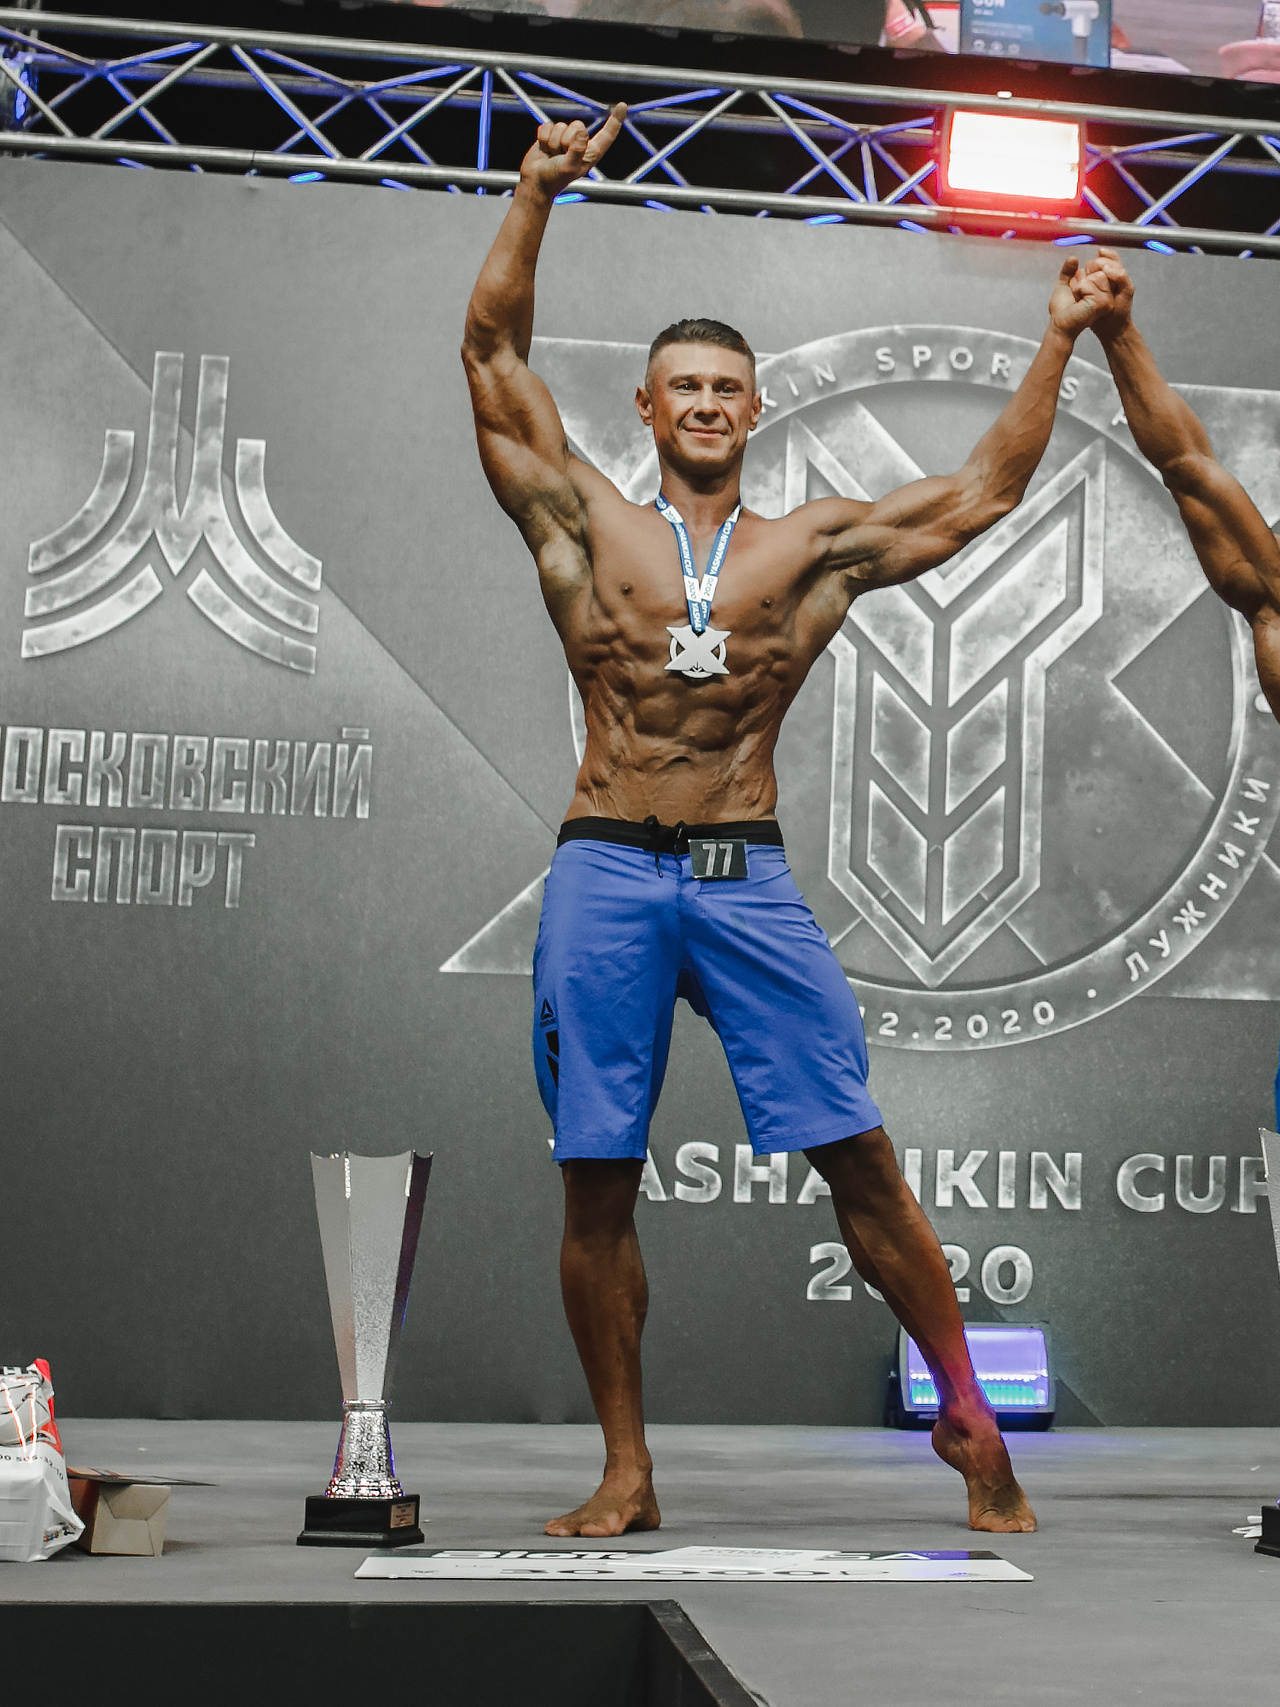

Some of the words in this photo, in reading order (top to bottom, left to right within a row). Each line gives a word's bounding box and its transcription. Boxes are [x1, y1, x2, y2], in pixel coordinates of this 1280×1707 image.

[876, 345, 1080, 401] SPORS
[704, 578, 714, 596] 2020
[0, 726, 373, 819] ОСКОВСКИЙ
[51, 824, 256, 909] СПОРТ
[702, 843, 733, 877] 77
[1126, 777, 1271, 983] ЛУЖНИКИ
[859, 1001, 1056, 1042] 2.2020
[548, 1138, 1082, 1212] SHKIN
[806, 1242, 1033, 1305] 220
